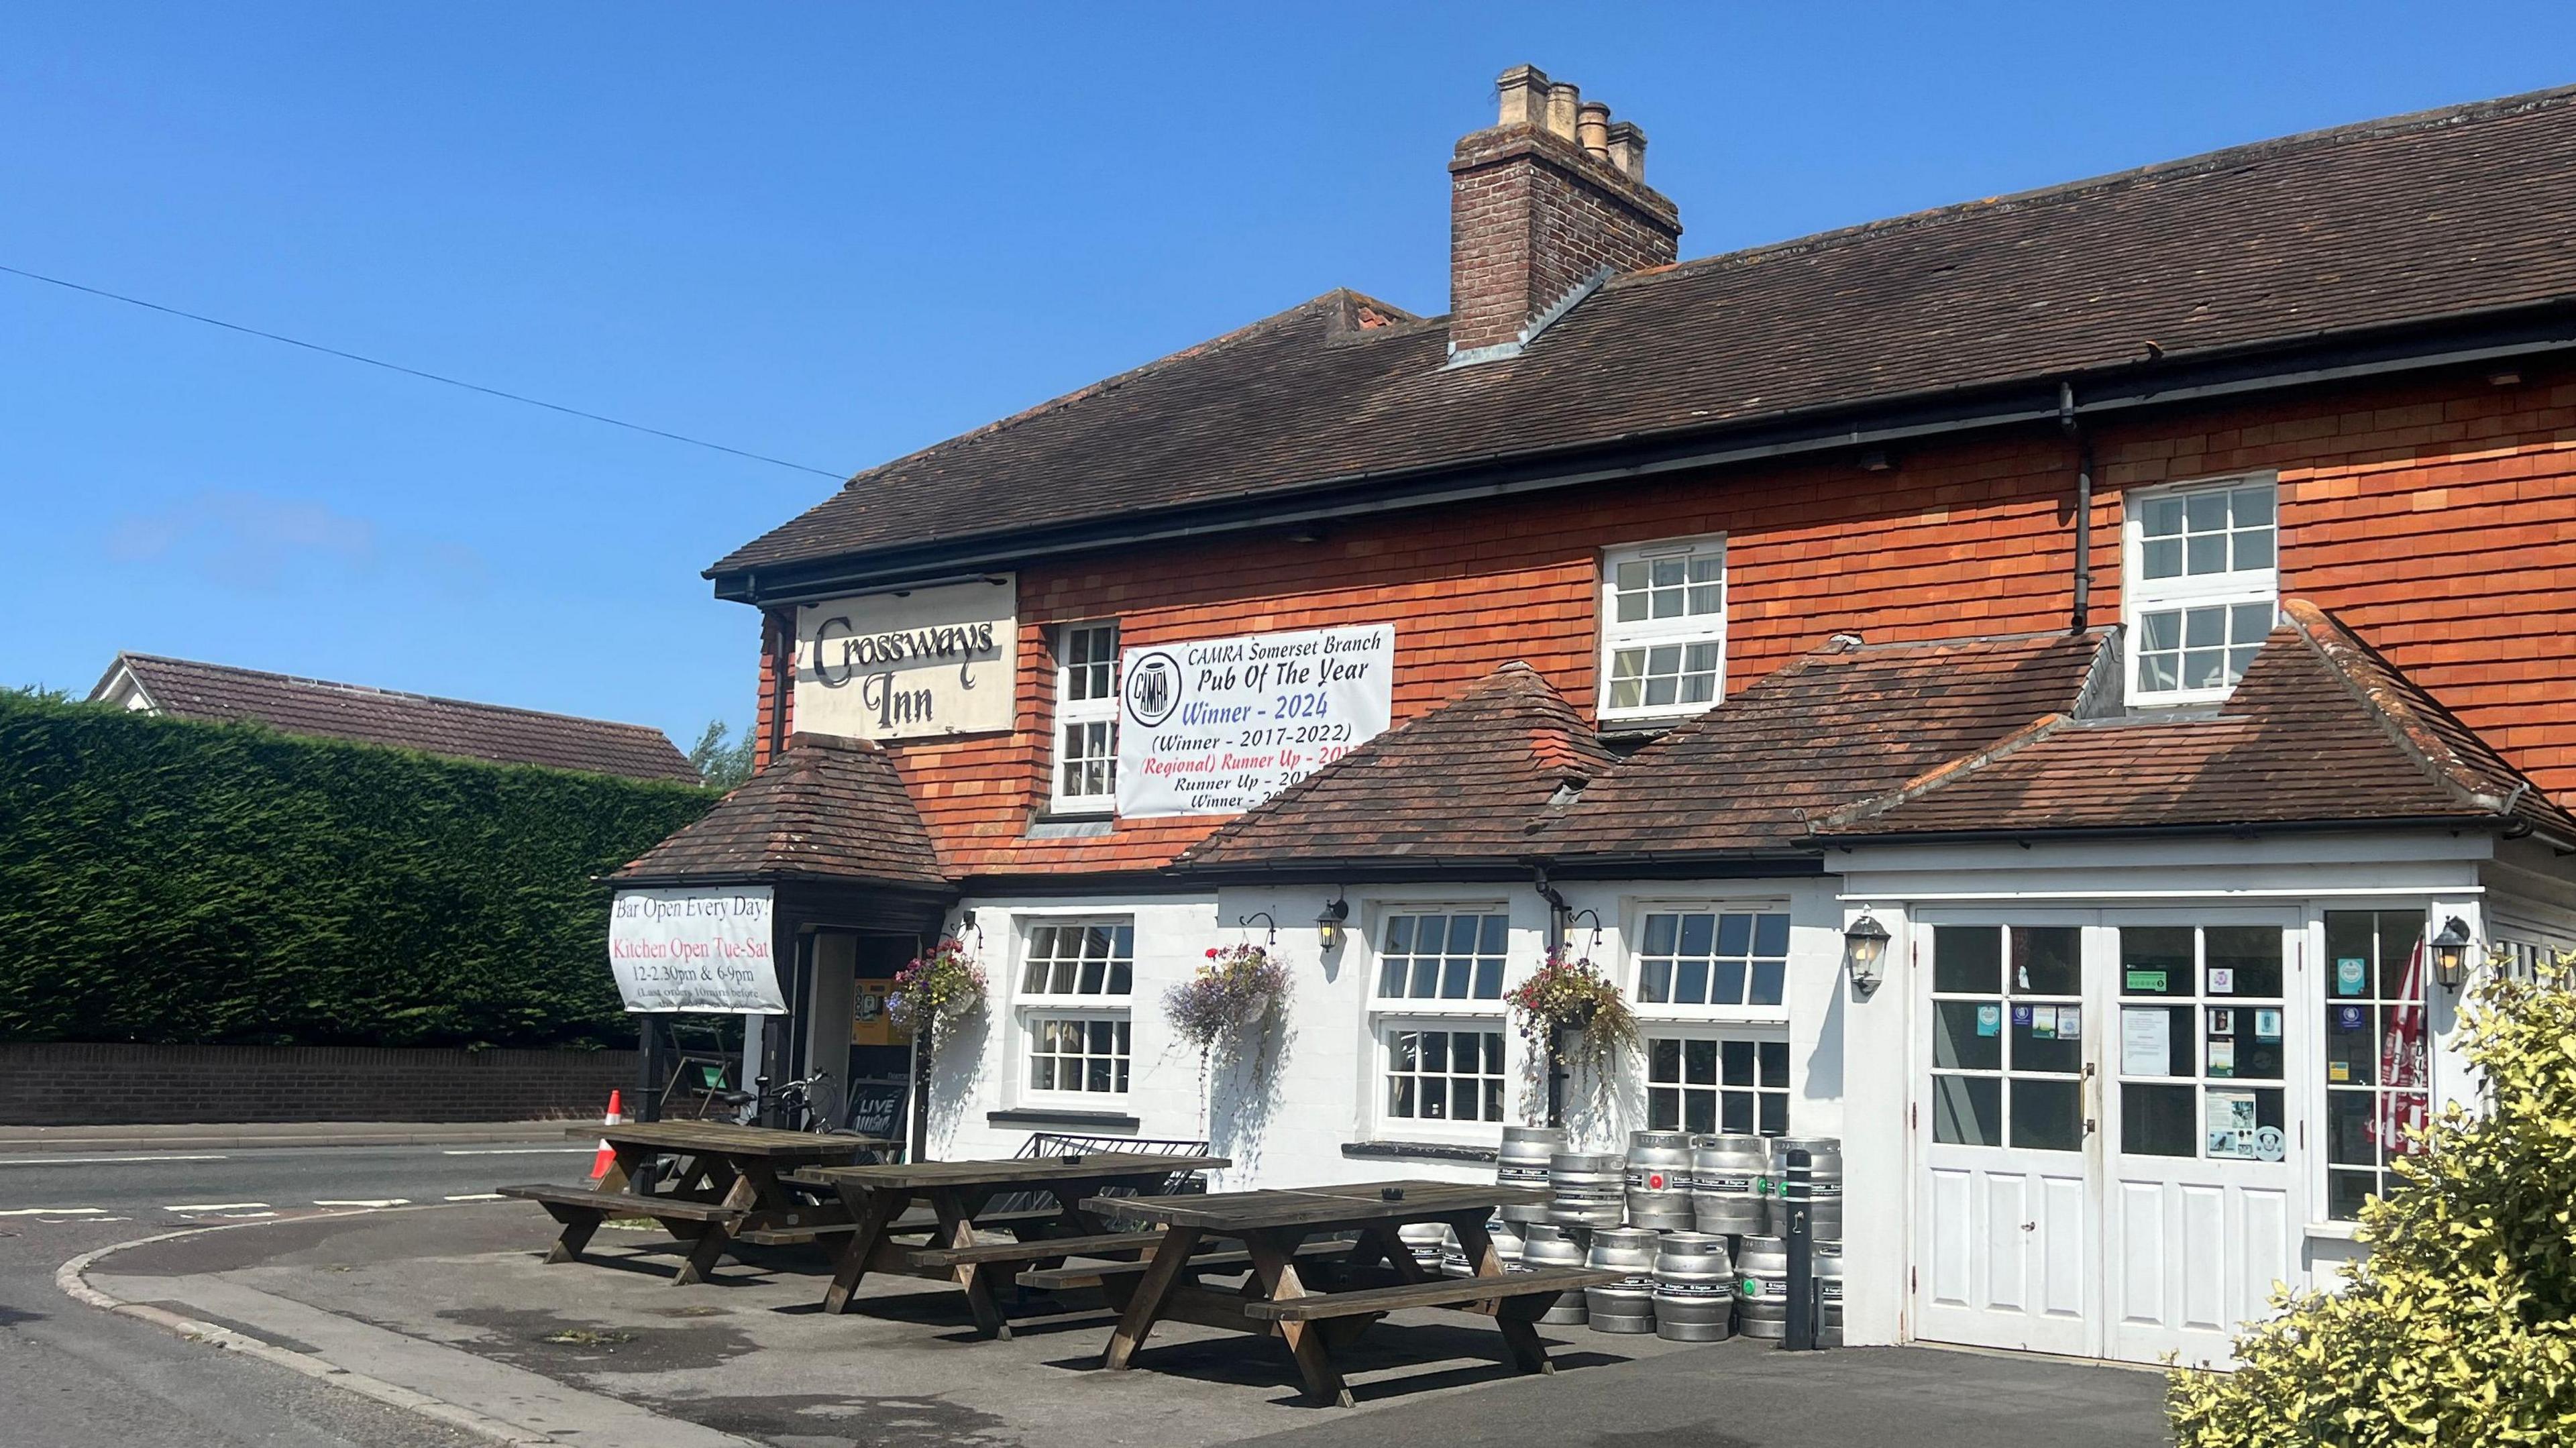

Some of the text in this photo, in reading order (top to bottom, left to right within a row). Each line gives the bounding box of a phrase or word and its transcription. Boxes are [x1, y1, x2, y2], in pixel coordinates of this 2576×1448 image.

[813, 616, 993, 690] Crossways
[1188, 630, 1381, 667] CAMRA Somerset Branch
[1197, 659, 1368, 694] Pub Of The Year
[863, 671, 933, 730] Inn
[1134, 670, 1168, 714] CAMRA
[1183, 700, 1251, 726] Winner
[1275, 691, 1328, 720] 2024
[1152, 734, 1220, 753] (Winner
[1240, 723, 1352, 748] 2017-2022)
[1141, 753, 1216, 778] (Regional)
[1221, 753, 1275, 771] Runner
[1279, 749, 1301, 771] Up
[1174, 777, 1232, 791] Runner
[1237, 773, 1258, 791] Up
[1191, 795, 1243, 808] Winner
[616, 895, 770, 923] Bar Open Every Day!
[614, 937, 769, 963] Kitchen Open Tue-Sat
[633, 965, 754, 985] 12-2.30pm & 6-9pm
[859, 1099, 895, 1113] LIVE
